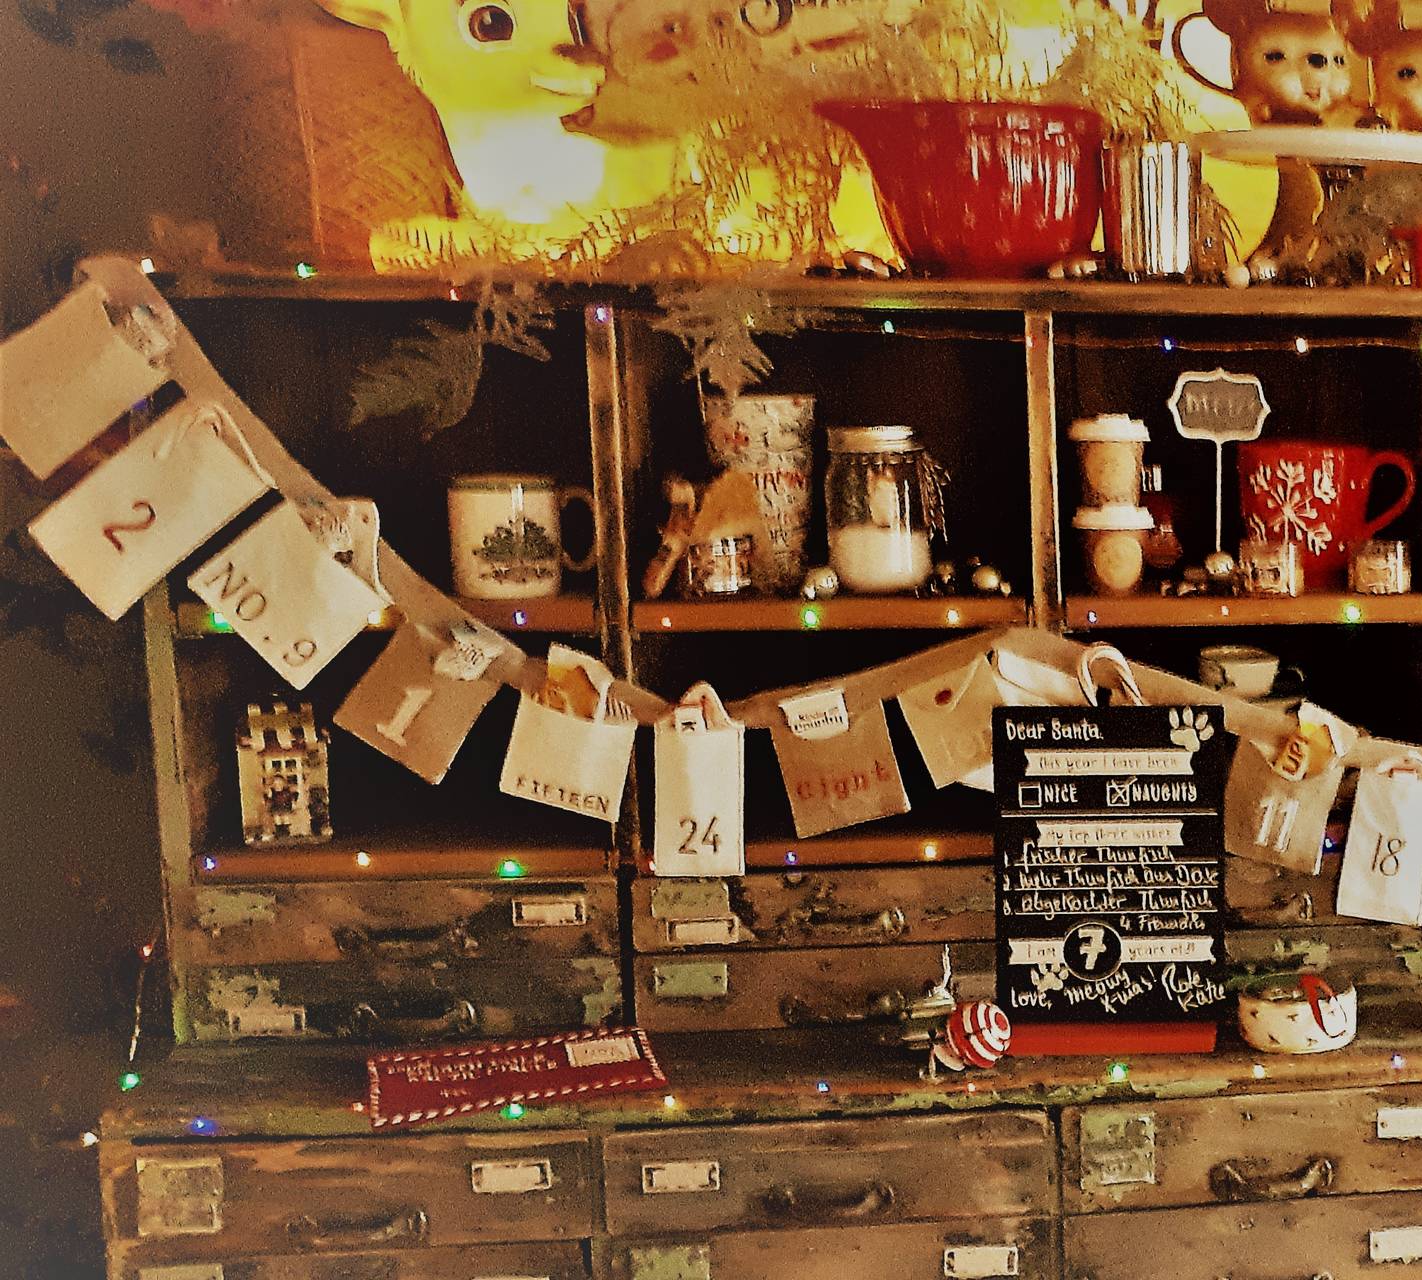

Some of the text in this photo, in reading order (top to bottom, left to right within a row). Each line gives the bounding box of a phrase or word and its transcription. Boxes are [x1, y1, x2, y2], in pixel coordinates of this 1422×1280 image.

[103, 500, 157, 553] 2
[375, 686, 434, 747] 1
[1005, 718, 1046, 741] Dear
[1043, 783, 1079, 804] NICE
[677, 816, 722, 855] 24
[1253, 797, 1301, 853] 11
[1370, 831, 1406, 878] 18
[1077, 927, 1108, 970] 7
